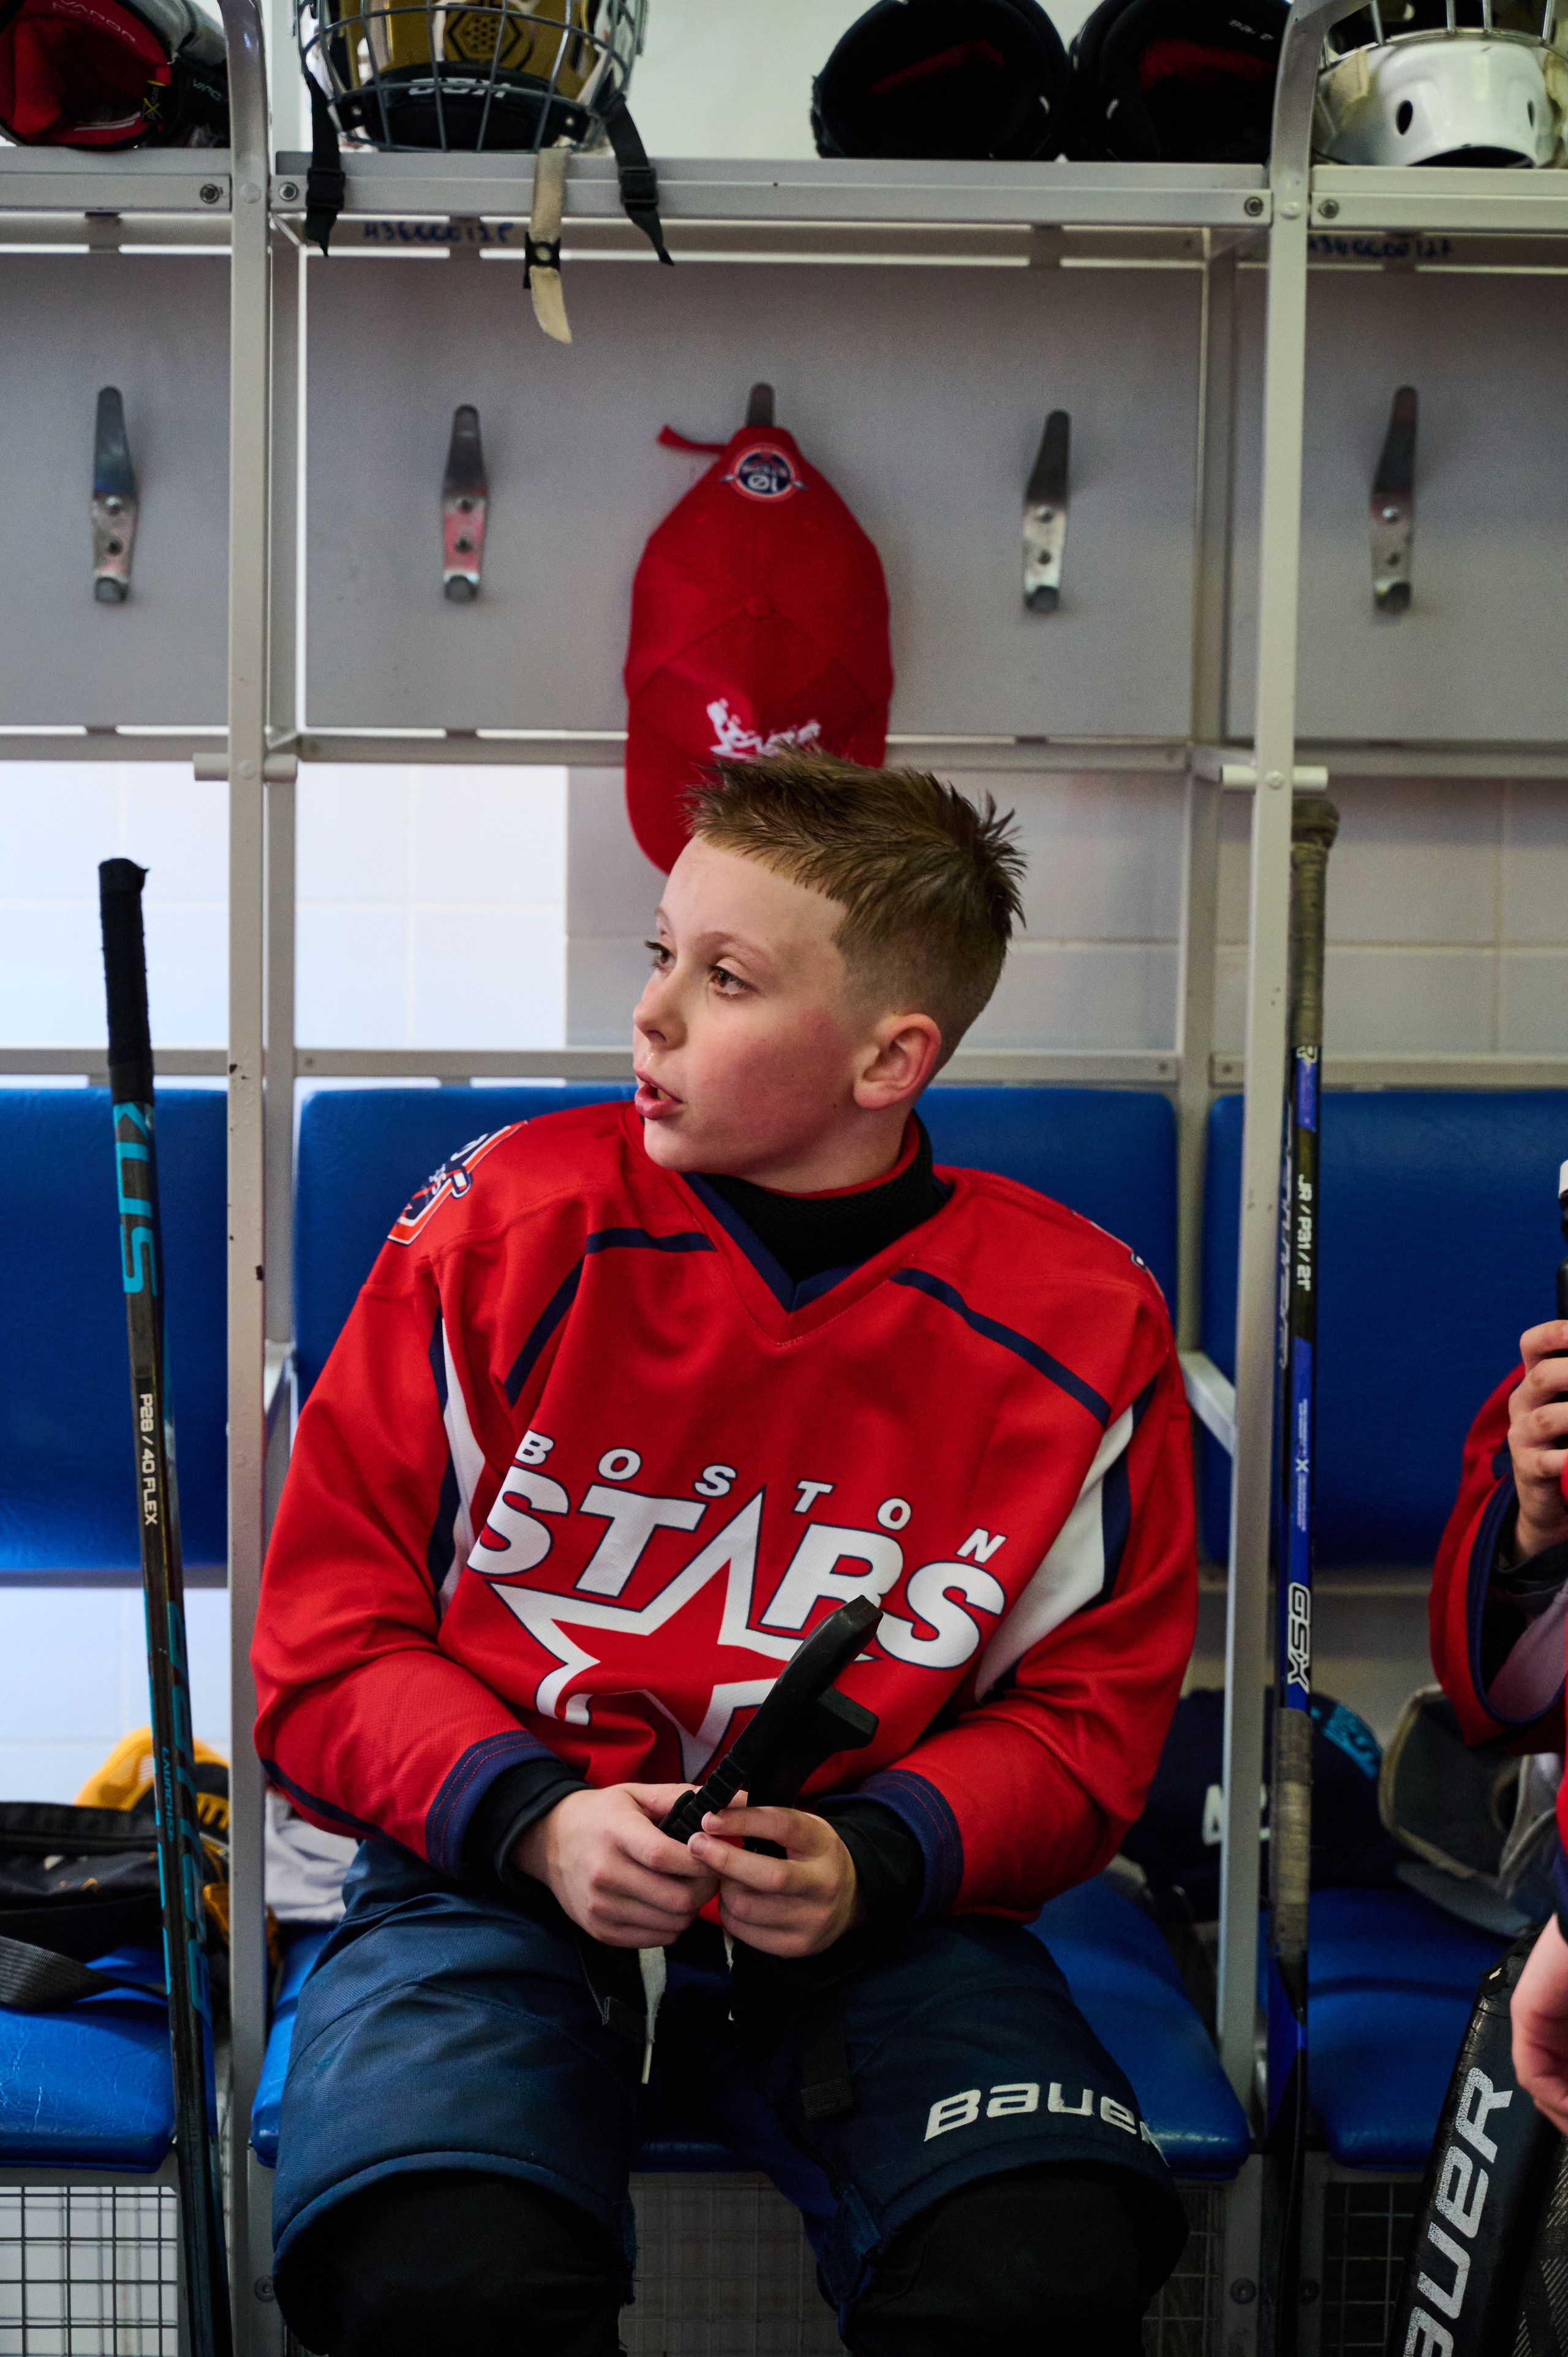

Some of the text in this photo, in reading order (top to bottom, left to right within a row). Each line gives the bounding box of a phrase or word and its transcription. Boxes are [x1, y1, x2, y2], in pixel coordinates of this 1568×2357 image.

[192, 78, 224, 101] VAPO
[1298, 1174, 1313, 1201] JR
[140, 1393, 154, 1431] P28
[141, 1448, 157, 1473] 40
[143, 1477, 159, 1526] FLEX
[513, 1428, 1008, 1565] BOSTON
[467, 1465, 1007, 1670] STARS
[1287, 1582, 1311, 1694] GSX
